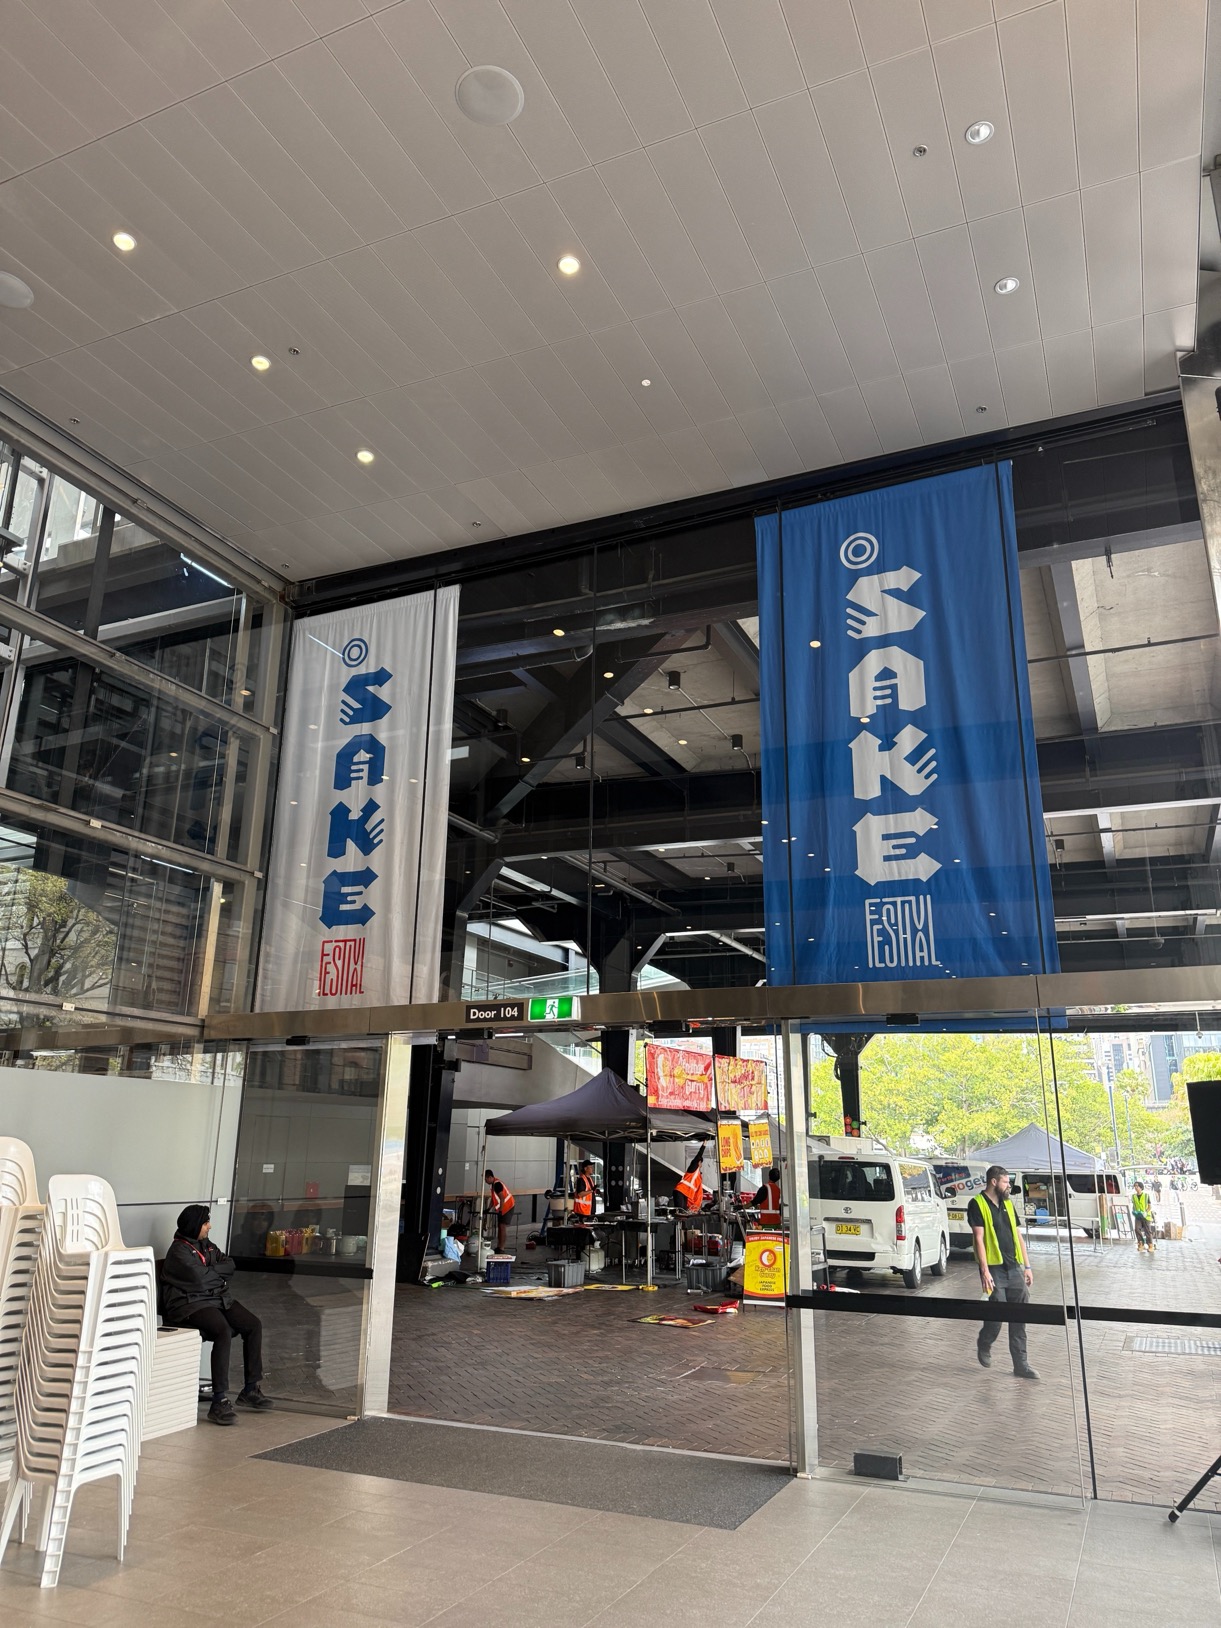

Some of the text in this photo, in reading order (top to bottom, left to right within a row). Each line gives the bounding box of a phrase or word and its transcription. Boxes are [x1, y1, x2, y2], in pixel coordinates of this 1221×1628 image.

[319, 666, 394, 930] SAKE
[845, 565, 943, 886] SAKE
[470, 1006, 518, 1019] Door 104
